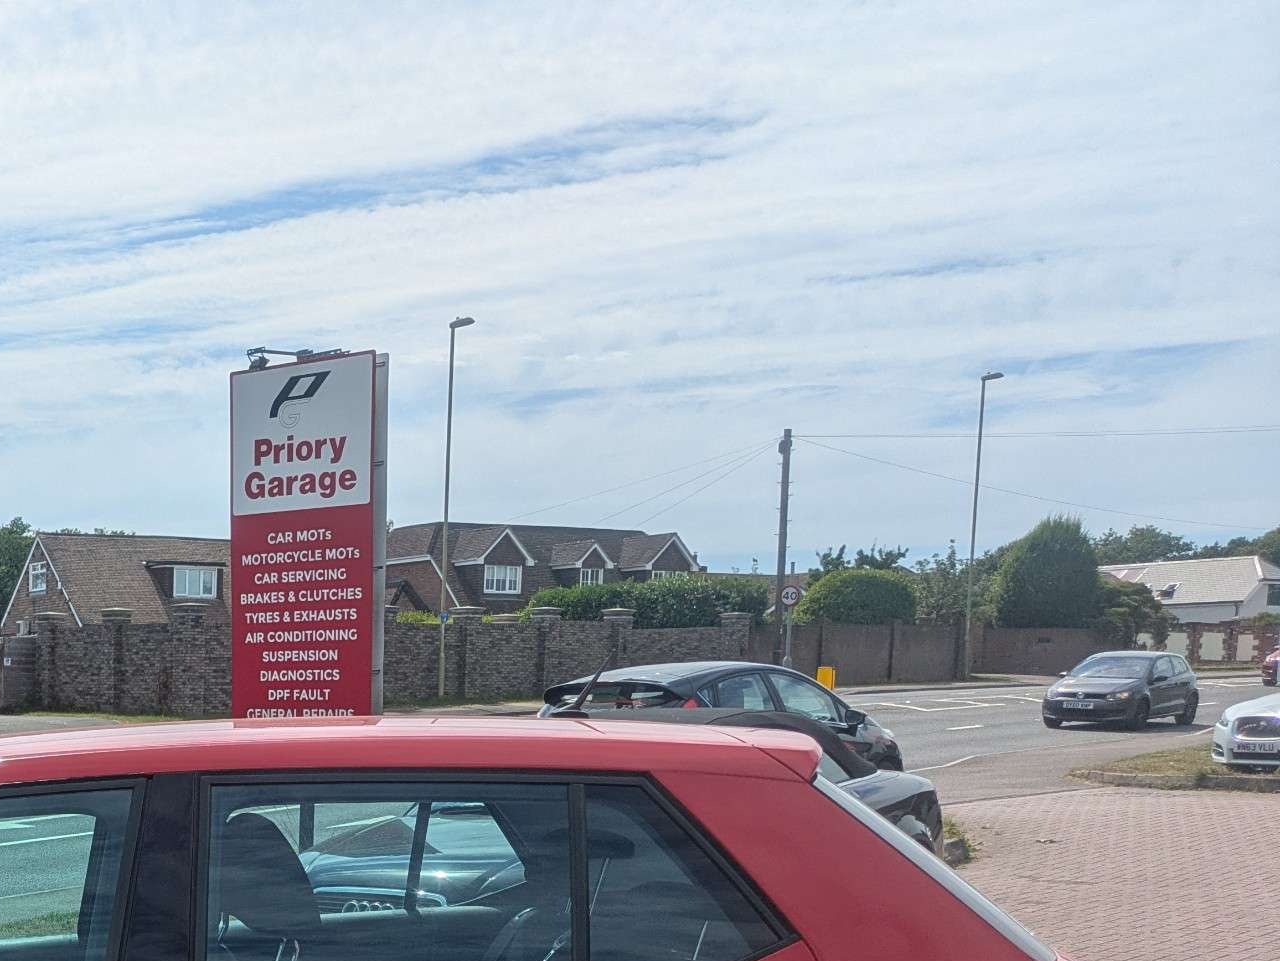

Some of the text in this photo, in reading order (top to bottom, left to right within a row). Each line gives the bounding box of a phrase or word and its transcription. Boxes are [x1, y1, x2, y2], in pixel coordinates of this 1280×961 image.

[254, 435, 347, 466] Priory
[244, 468, 357, 500] Garage
[267, 528, 332, 544] CAR MOTs
[241, 547, 360, 566] MOTORCYCLE MOTs
[254, 568, 346, 584] CAR SERVICING
[240, 587, 363, 605] BRAKES & CLUTCHES
[783, 591, 797, 601] 40
[245, 608, 357, 624] TYRES & EXHAUSTS
[245, 628, 358, 644] AIR CONDITIONING
[262, 649, 338, 662] SUSPENSION
[260, 669, 340, 682] DIAGNOSTICS
[268, 689, 331, 701] DPF FAULT
[246, 708, 297, 719] GENERAL
